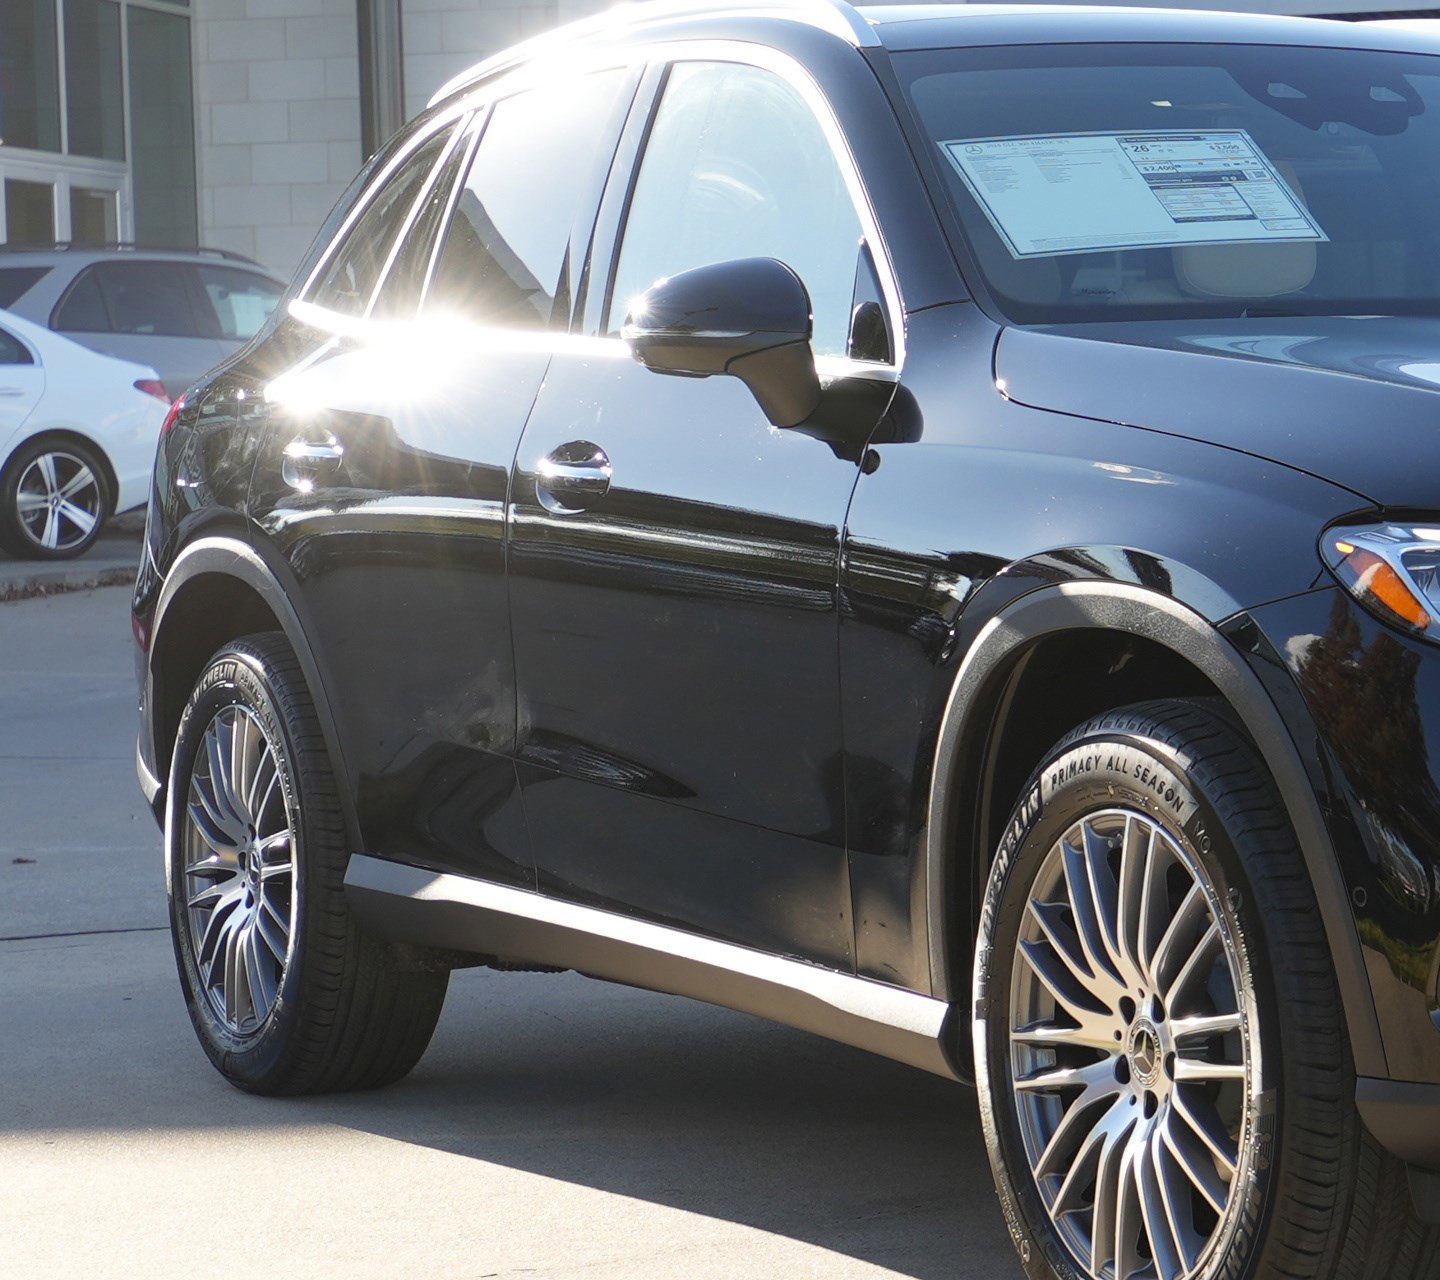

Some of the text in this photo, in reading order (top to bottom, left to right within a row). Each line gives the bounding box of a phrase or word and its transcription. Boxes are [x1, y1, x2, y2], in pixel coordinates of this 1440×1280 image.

[1130, 144, 1150, 153] 26
[1050, 754, 1101, 791] PRIMACY
[1105, 755, 1129, 775] ALL
[1132, 763, 1185, 814] SEASON
